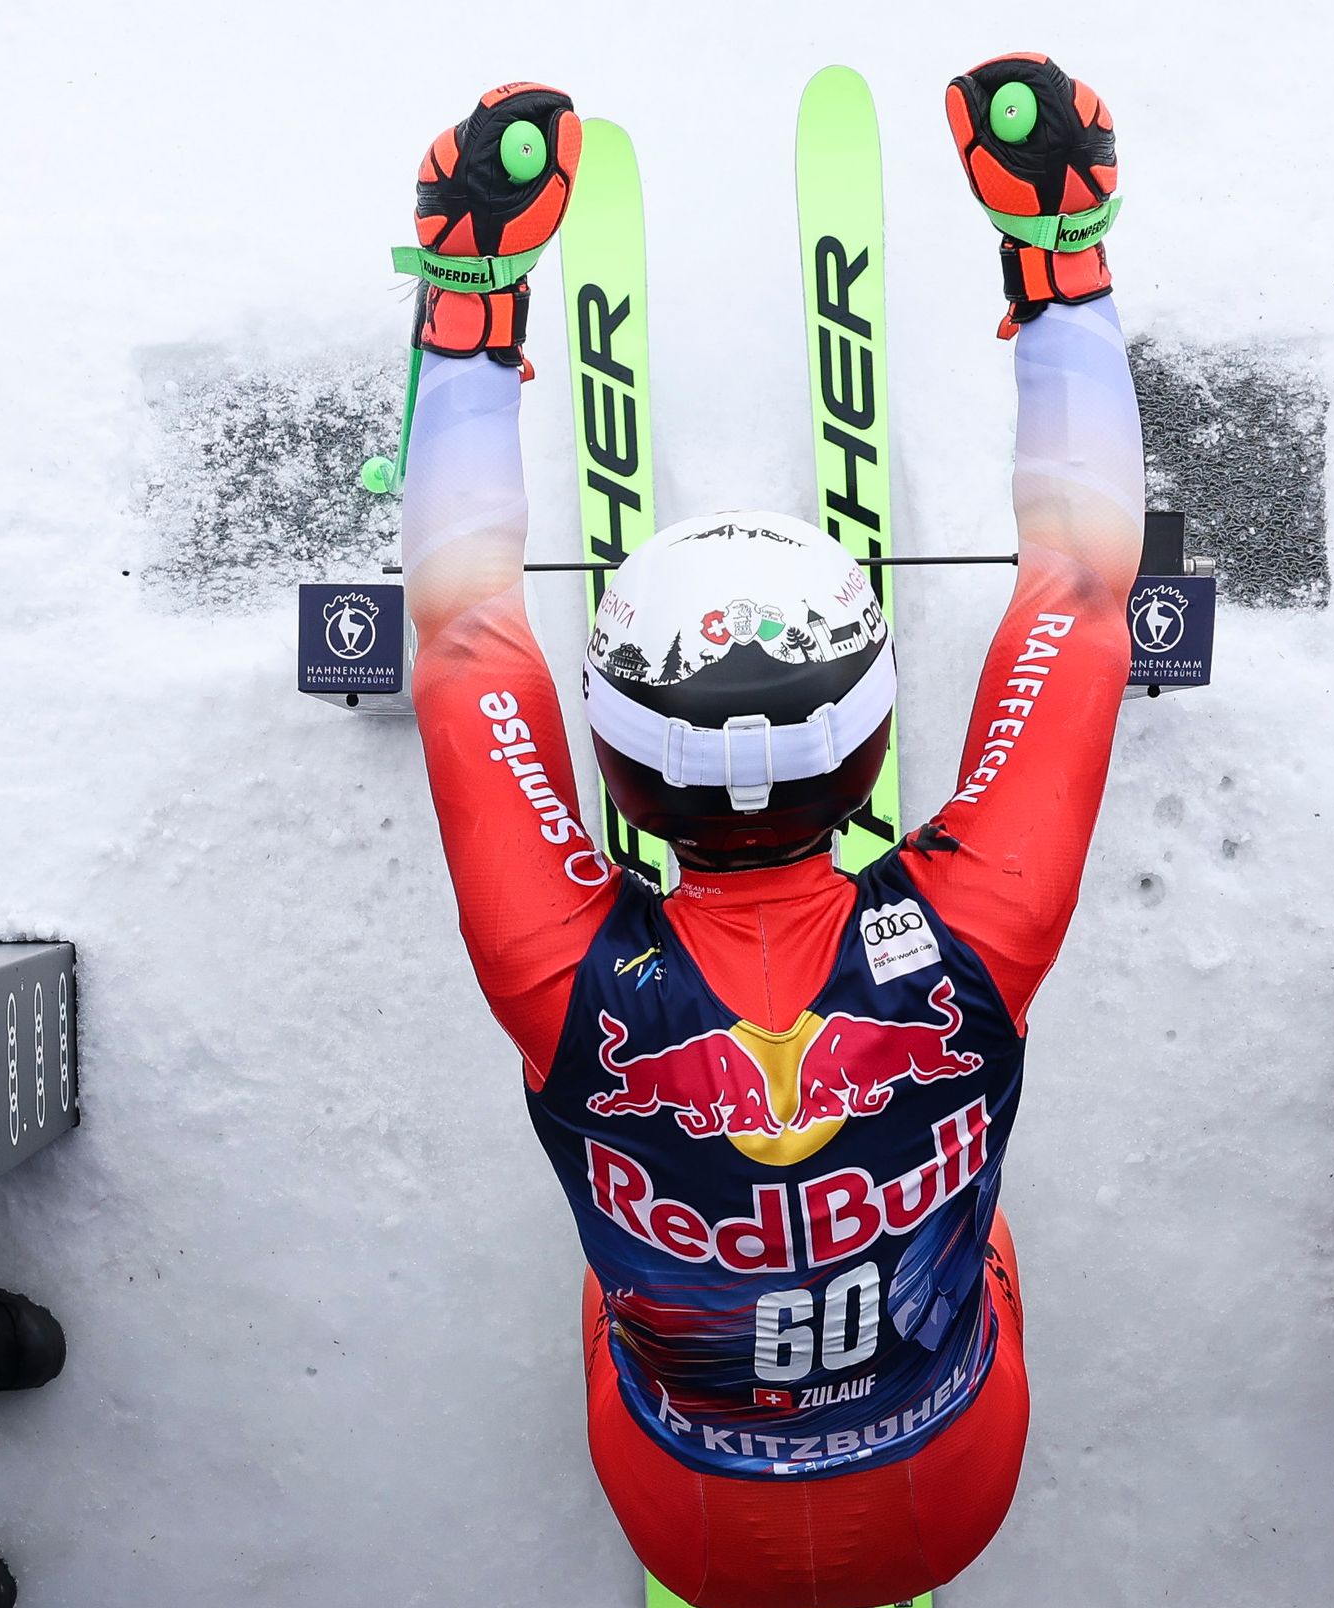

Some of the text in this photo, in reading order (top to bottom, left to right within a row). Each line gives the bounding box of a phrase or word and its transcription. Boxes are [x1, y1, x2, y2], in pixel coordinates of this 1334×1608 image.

[307, 665, 395, 675] HAHNENKAMM
[1130, 660, 1202, 669] HNENKAMM
[1154, 669, 1202, 677] KITZBÜHEL
[347, 675, 394, 684] KITZBÜHEL
[950, 612, 1076, 804] RAIFFEISEN
[478, 690, 586, 845] sunrise
[872, 952, 889, 963] Audi
[874, 943, 933, 969] FIS Ski World Cup
[613, 957, 664, 981] FIS
[585, 1094, 991, 1273] Red Bull
[753, 1260, 880, 1382] 60
[798, 1373, 877, 1409] ZULAUF
